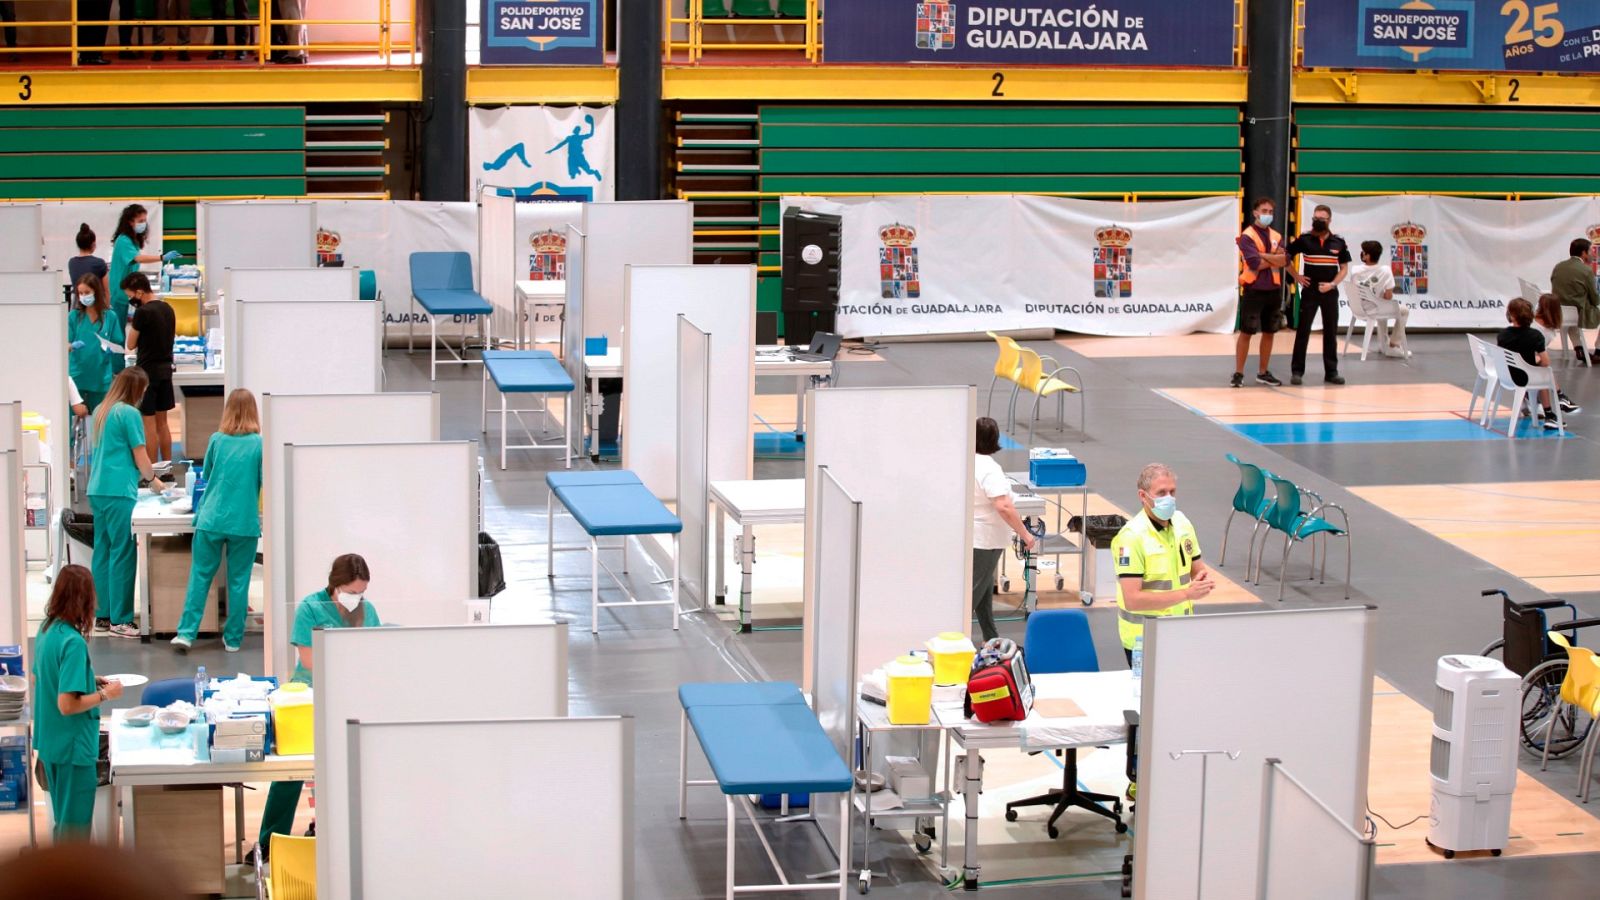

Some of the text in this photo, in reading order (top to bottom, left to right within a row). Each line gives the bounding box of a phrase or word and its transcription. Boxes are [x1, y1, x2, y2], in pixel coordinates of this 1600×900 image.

[500, 6, 584, 16] POLIDEPORTIVO
[967, 4, 1144, 29] DIPUTACIÓN DE
[500, 14, 582, 31] SAN JOSÉ
[1373, 14, 1460, 25] POLIDEPORTIVO
[1500, 0, 1565, 48] 25
[1373, 25, 1457, 40] SAN JOSÉ
[966, 29, 1148, 51] GUADALAJARA
[1563, 39, 1580, 47] CON
[1581, 35, 1591, 43] EL
[1505, 44, 1534, 58] AÑOS
[1560, 54, 1571, 63] DE
[1572, 52, 1583, 60] LA
[19, 75, 31, 101] 3
[992, 72, 1004, 97] 2
[1509, 79, 1520, 102] 2
[896, 307, 908, 315] DE
[911, 303, 1004, 315] GUADALAJARA
[1025, 302, 1214, 314] DIPUTACIÓN DE GUADALAJARA
[1419, 299, 1504, 310] GUADALAJARA
[384, 312, 429, 324] AJARA
